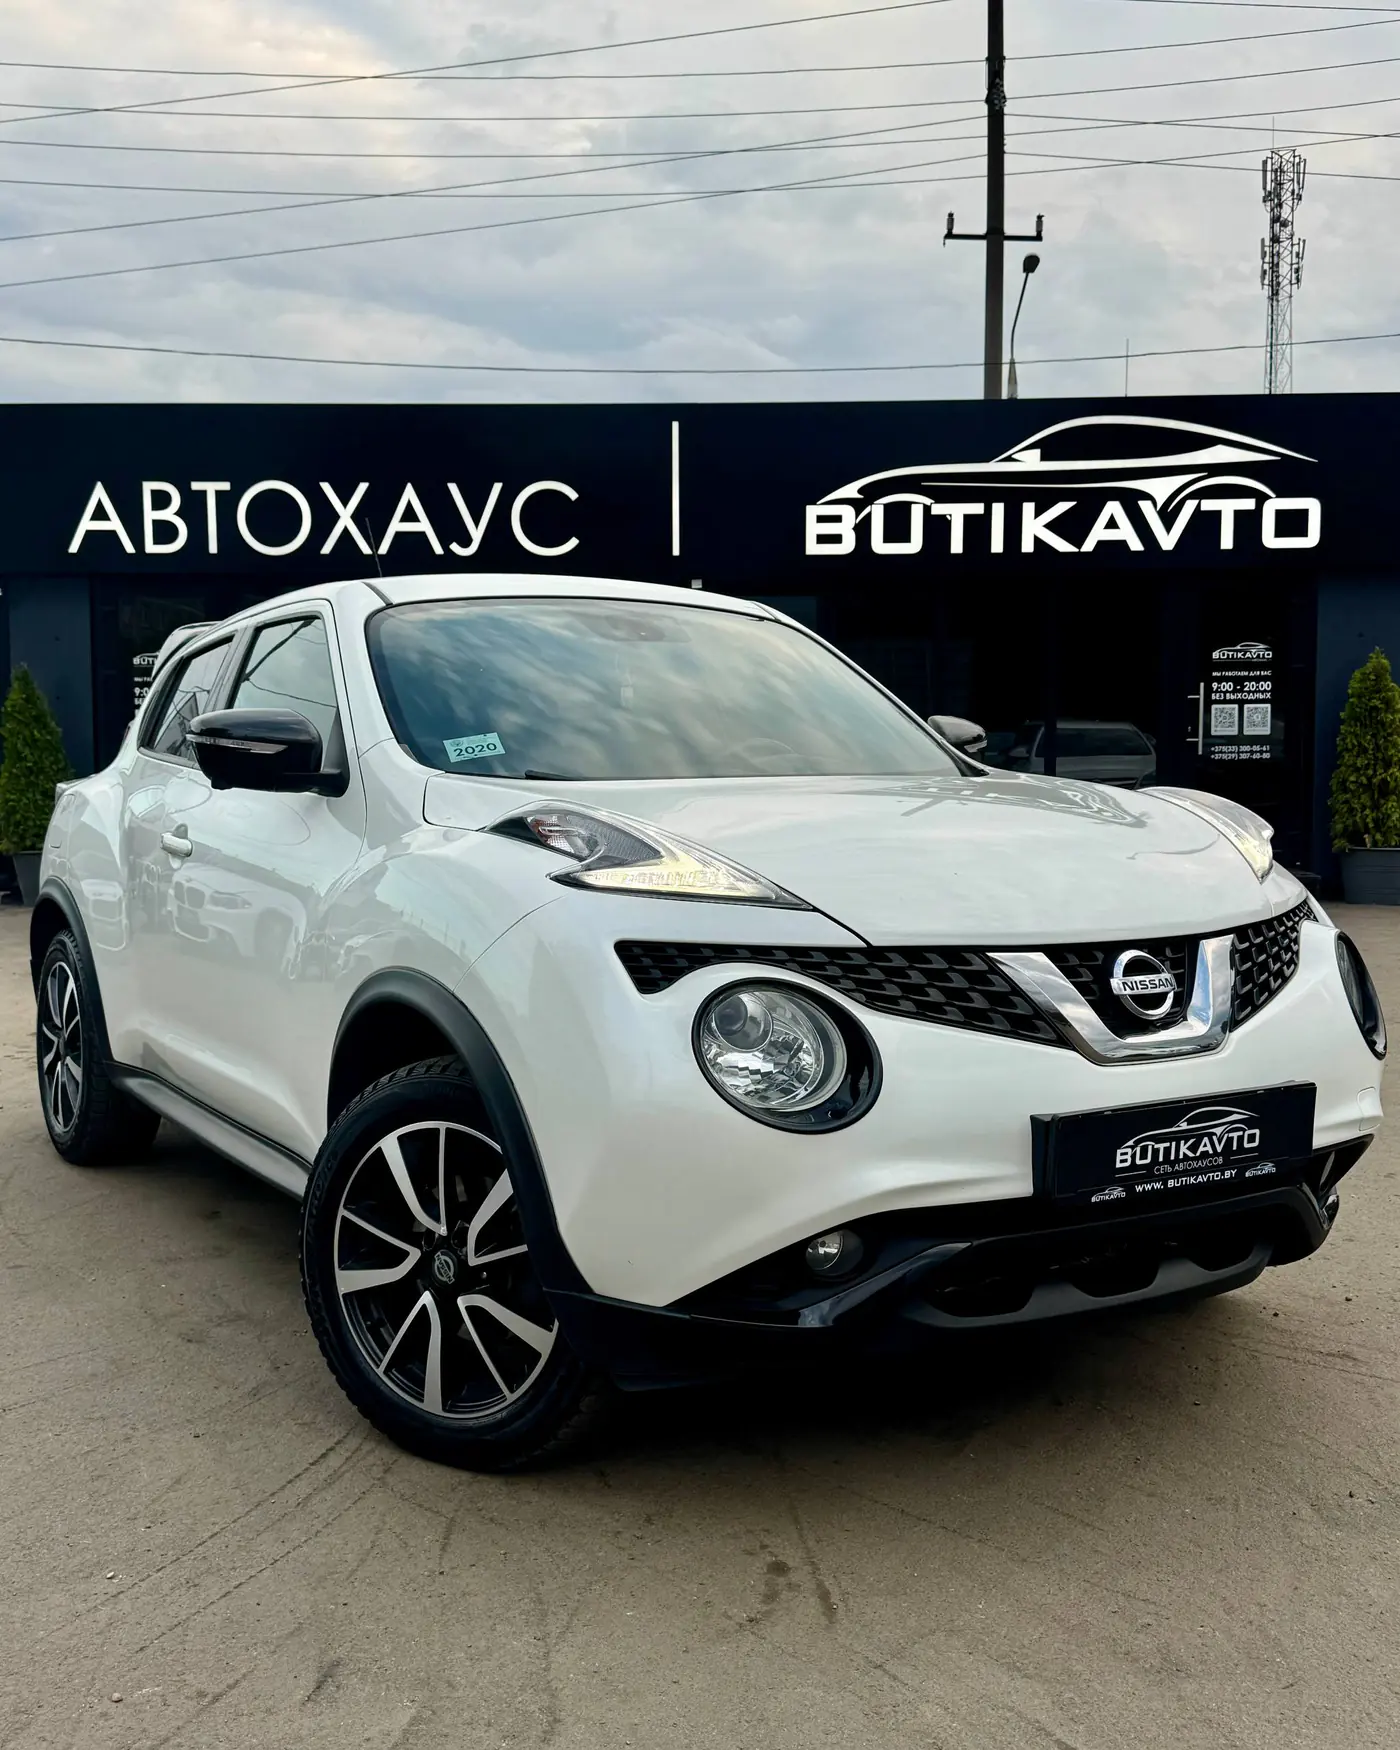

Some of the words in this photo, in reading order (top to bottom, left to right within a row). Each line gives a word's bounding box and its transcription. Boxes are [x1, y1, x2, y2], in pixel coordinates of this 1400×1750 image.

[68, 479, 581, 557] АВТОХАУС
[805, 497, 1322, 556] BUTIKAVTO
[1212, 651, 1272, 659] BUTIKAVTO
[134, 687, 150, 697] 9:0
[1211, 682, 1234, 691] 9:00
[1243, 681, 1272, 691] 20:00
[1211, 692, 1224, 700] БЕЗ
[1225, 692, 1271, 700] ВЫХОДНЫХ
[453, 742, 498, 757] 2020
[1121, 977, 1174, 992] NISSAN
[1115, 1128, 1260, 1168] BUTIKAVTO
[1154, 1163, 1173, 1174] СЕТЬ
[1173, 1156, 1224, 1172] АВТОХАУСОВ
[1135, 1181, 1164, 1193] WWW.
[1167, 1168, 1238, 1188] BUTIKAVTO.BY
